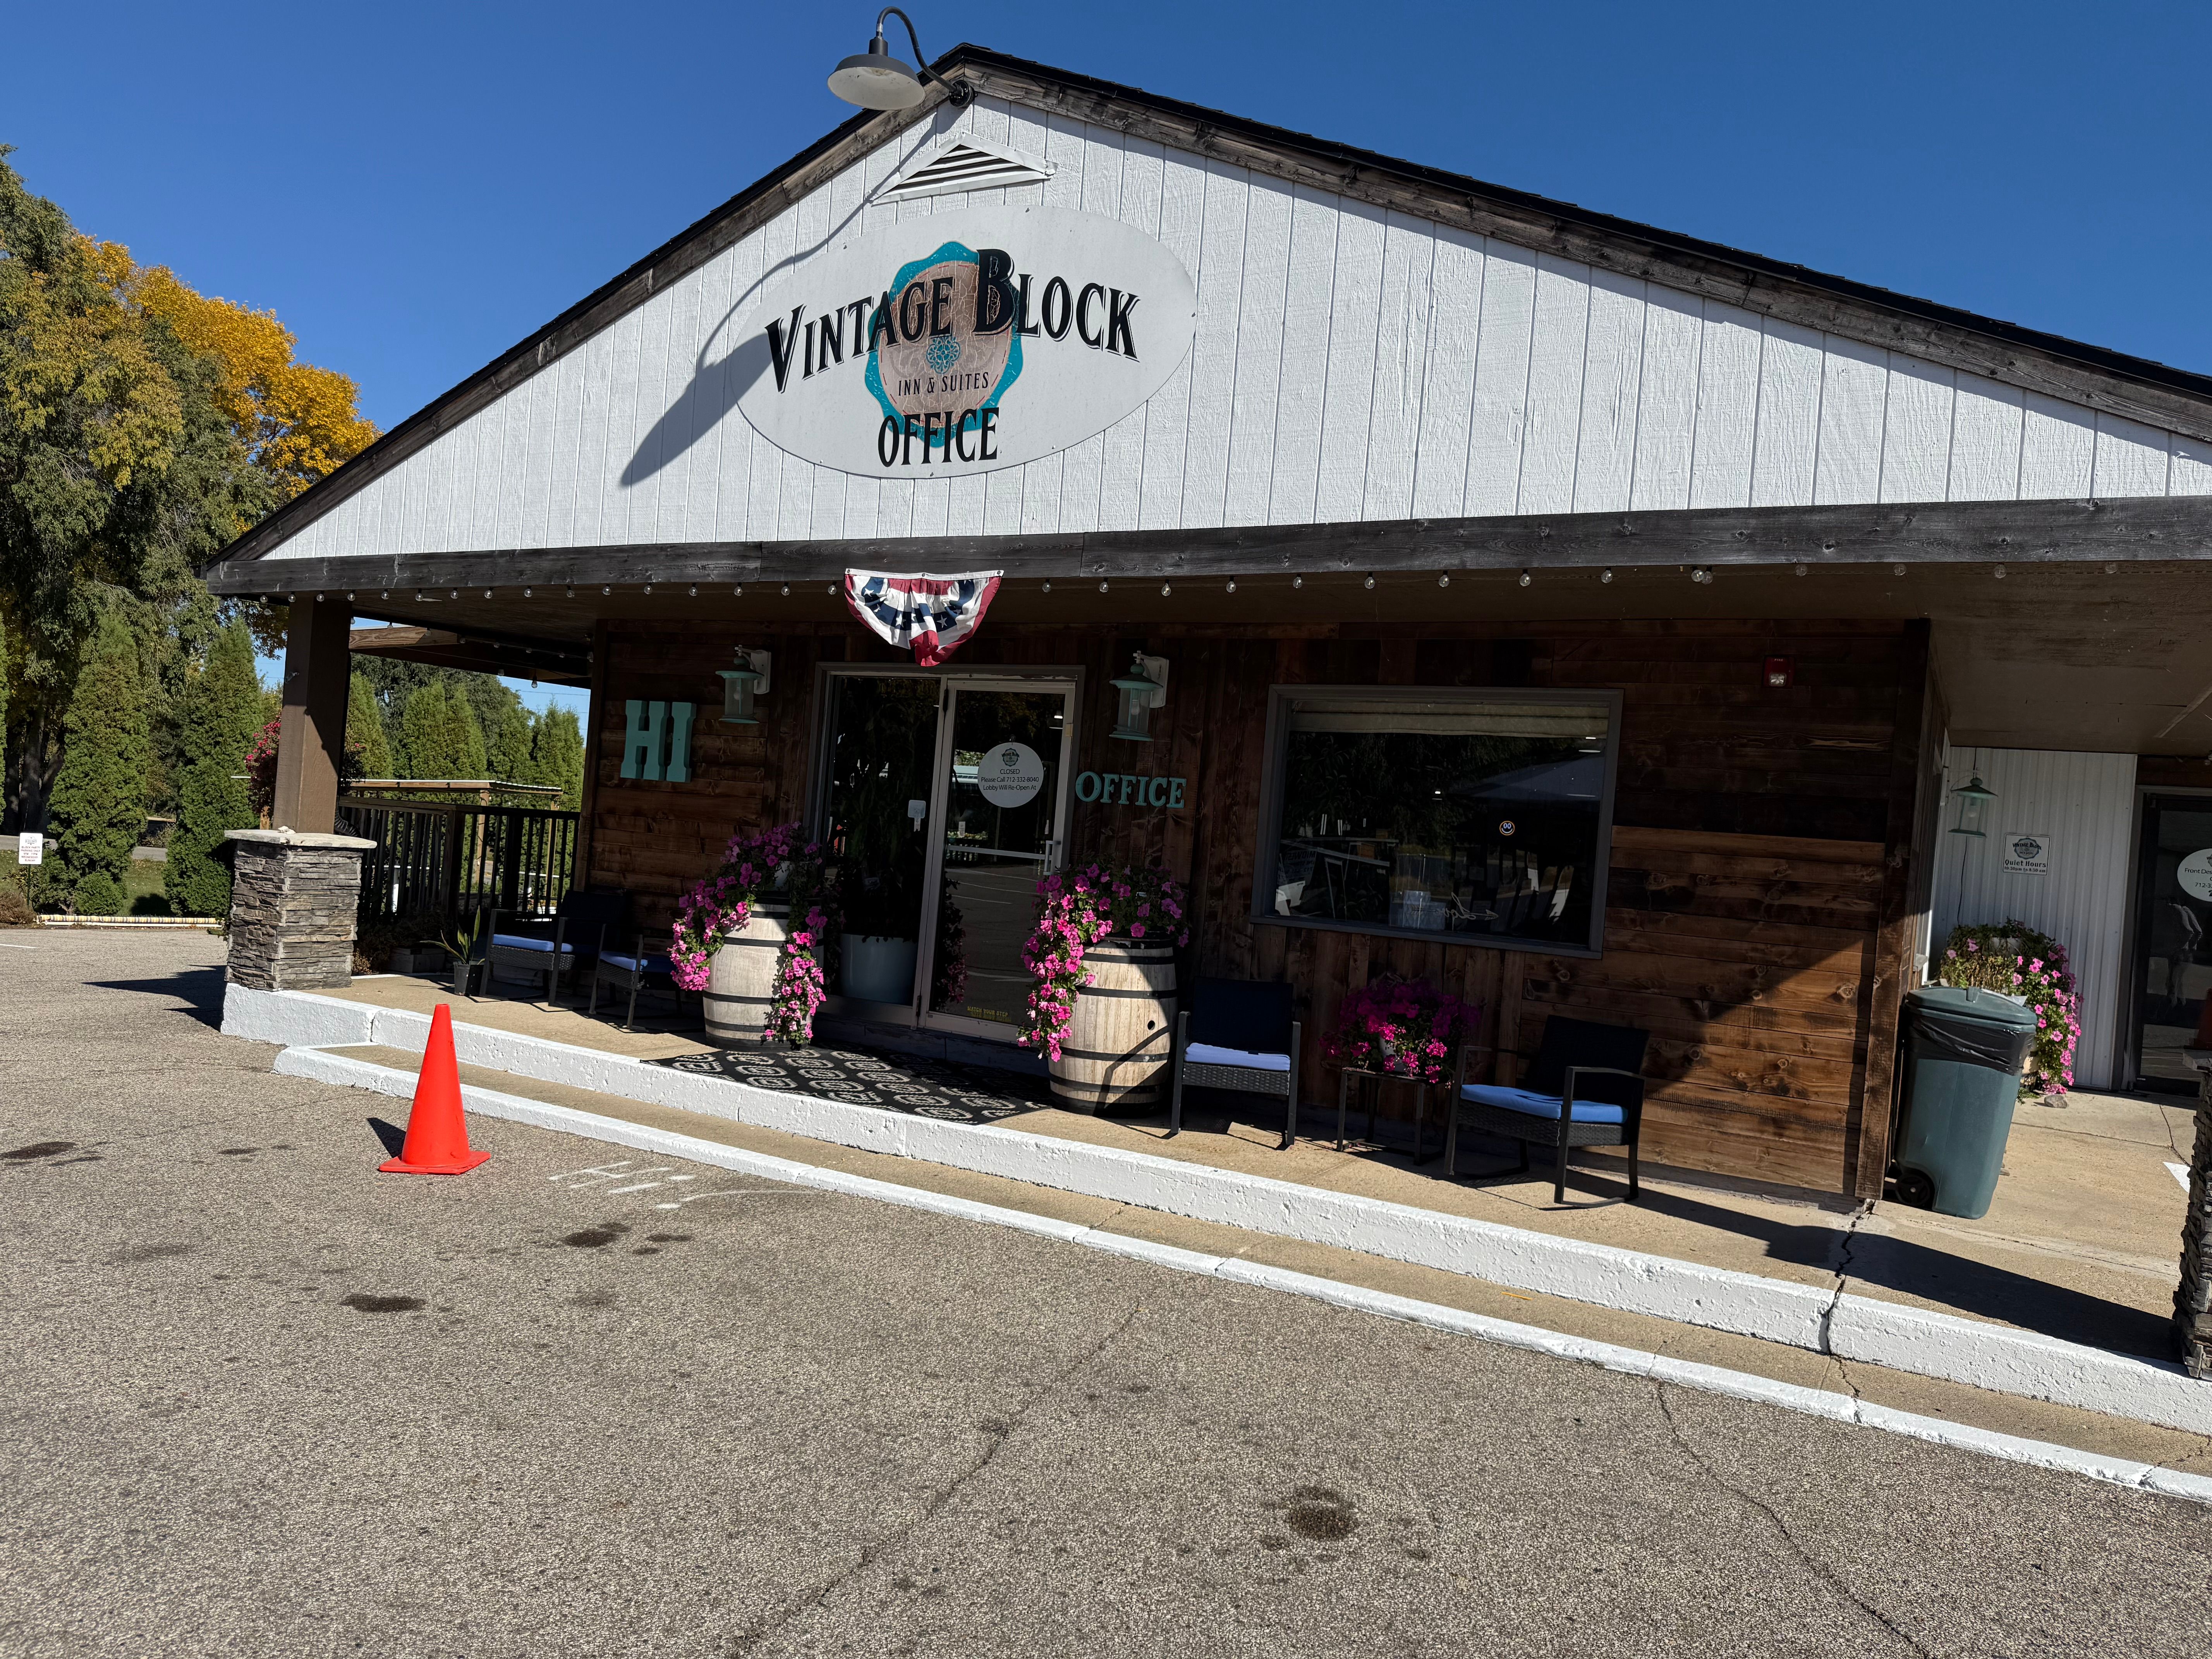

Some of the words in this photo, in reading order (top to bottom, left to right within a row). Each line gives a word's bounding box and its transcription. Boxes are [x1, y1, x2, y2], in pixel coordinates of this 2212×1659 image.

[764, 276, 955, 394] VINTAGE
[972, 249, 1142, 362] BLOCK
[898, 379, 921, 396] INN
[927, 378, 934, 393] &
[942, 372, 988, 392] SUITES
[878, 407, 1000, 467] OFFICE
[620, 700, 697, 783] HI
[1075, 771, 1187, 809] OFFICE
